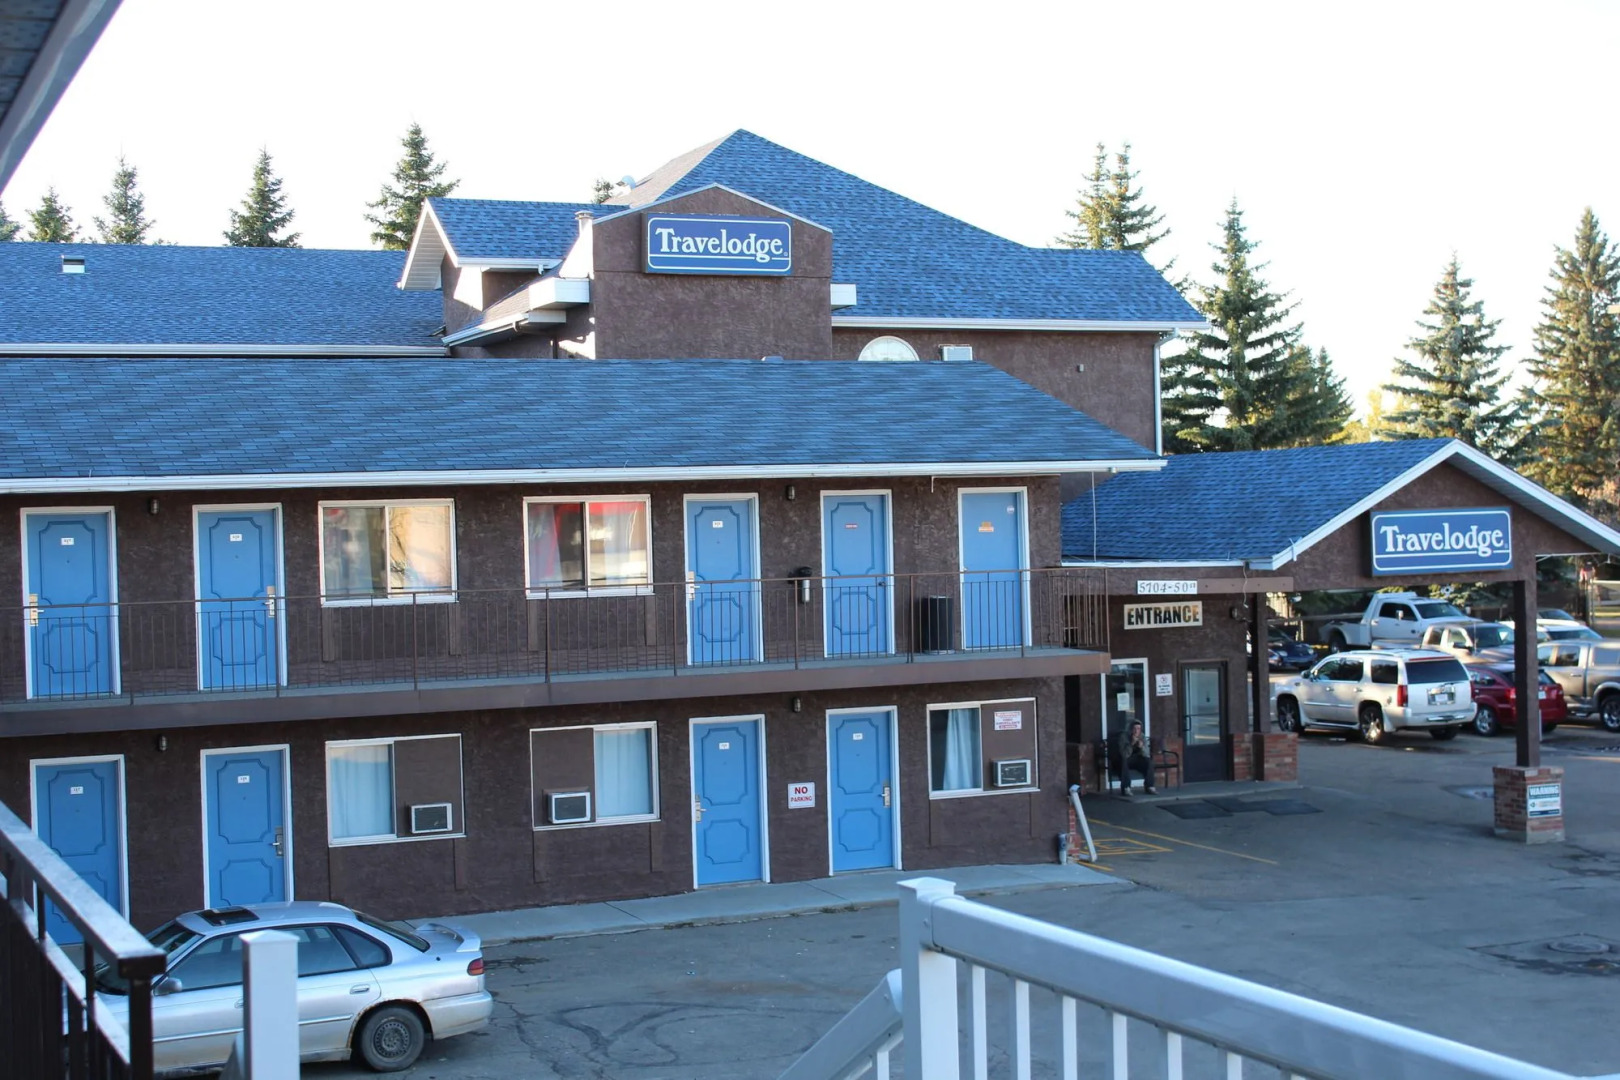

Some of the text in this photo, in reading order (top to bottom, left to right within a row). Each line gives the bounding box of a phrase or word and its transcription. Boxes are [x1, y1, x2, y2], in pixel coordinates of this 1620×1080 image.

[655, 228, 783, 263] Travelodge
[1380, 522, 1504, 557] Travelodge
[1127, 605, 1199, 625] ENTRANCE
[794, 786, 808, 794] NO
[1530, 786, 1559, 795] WARNING
